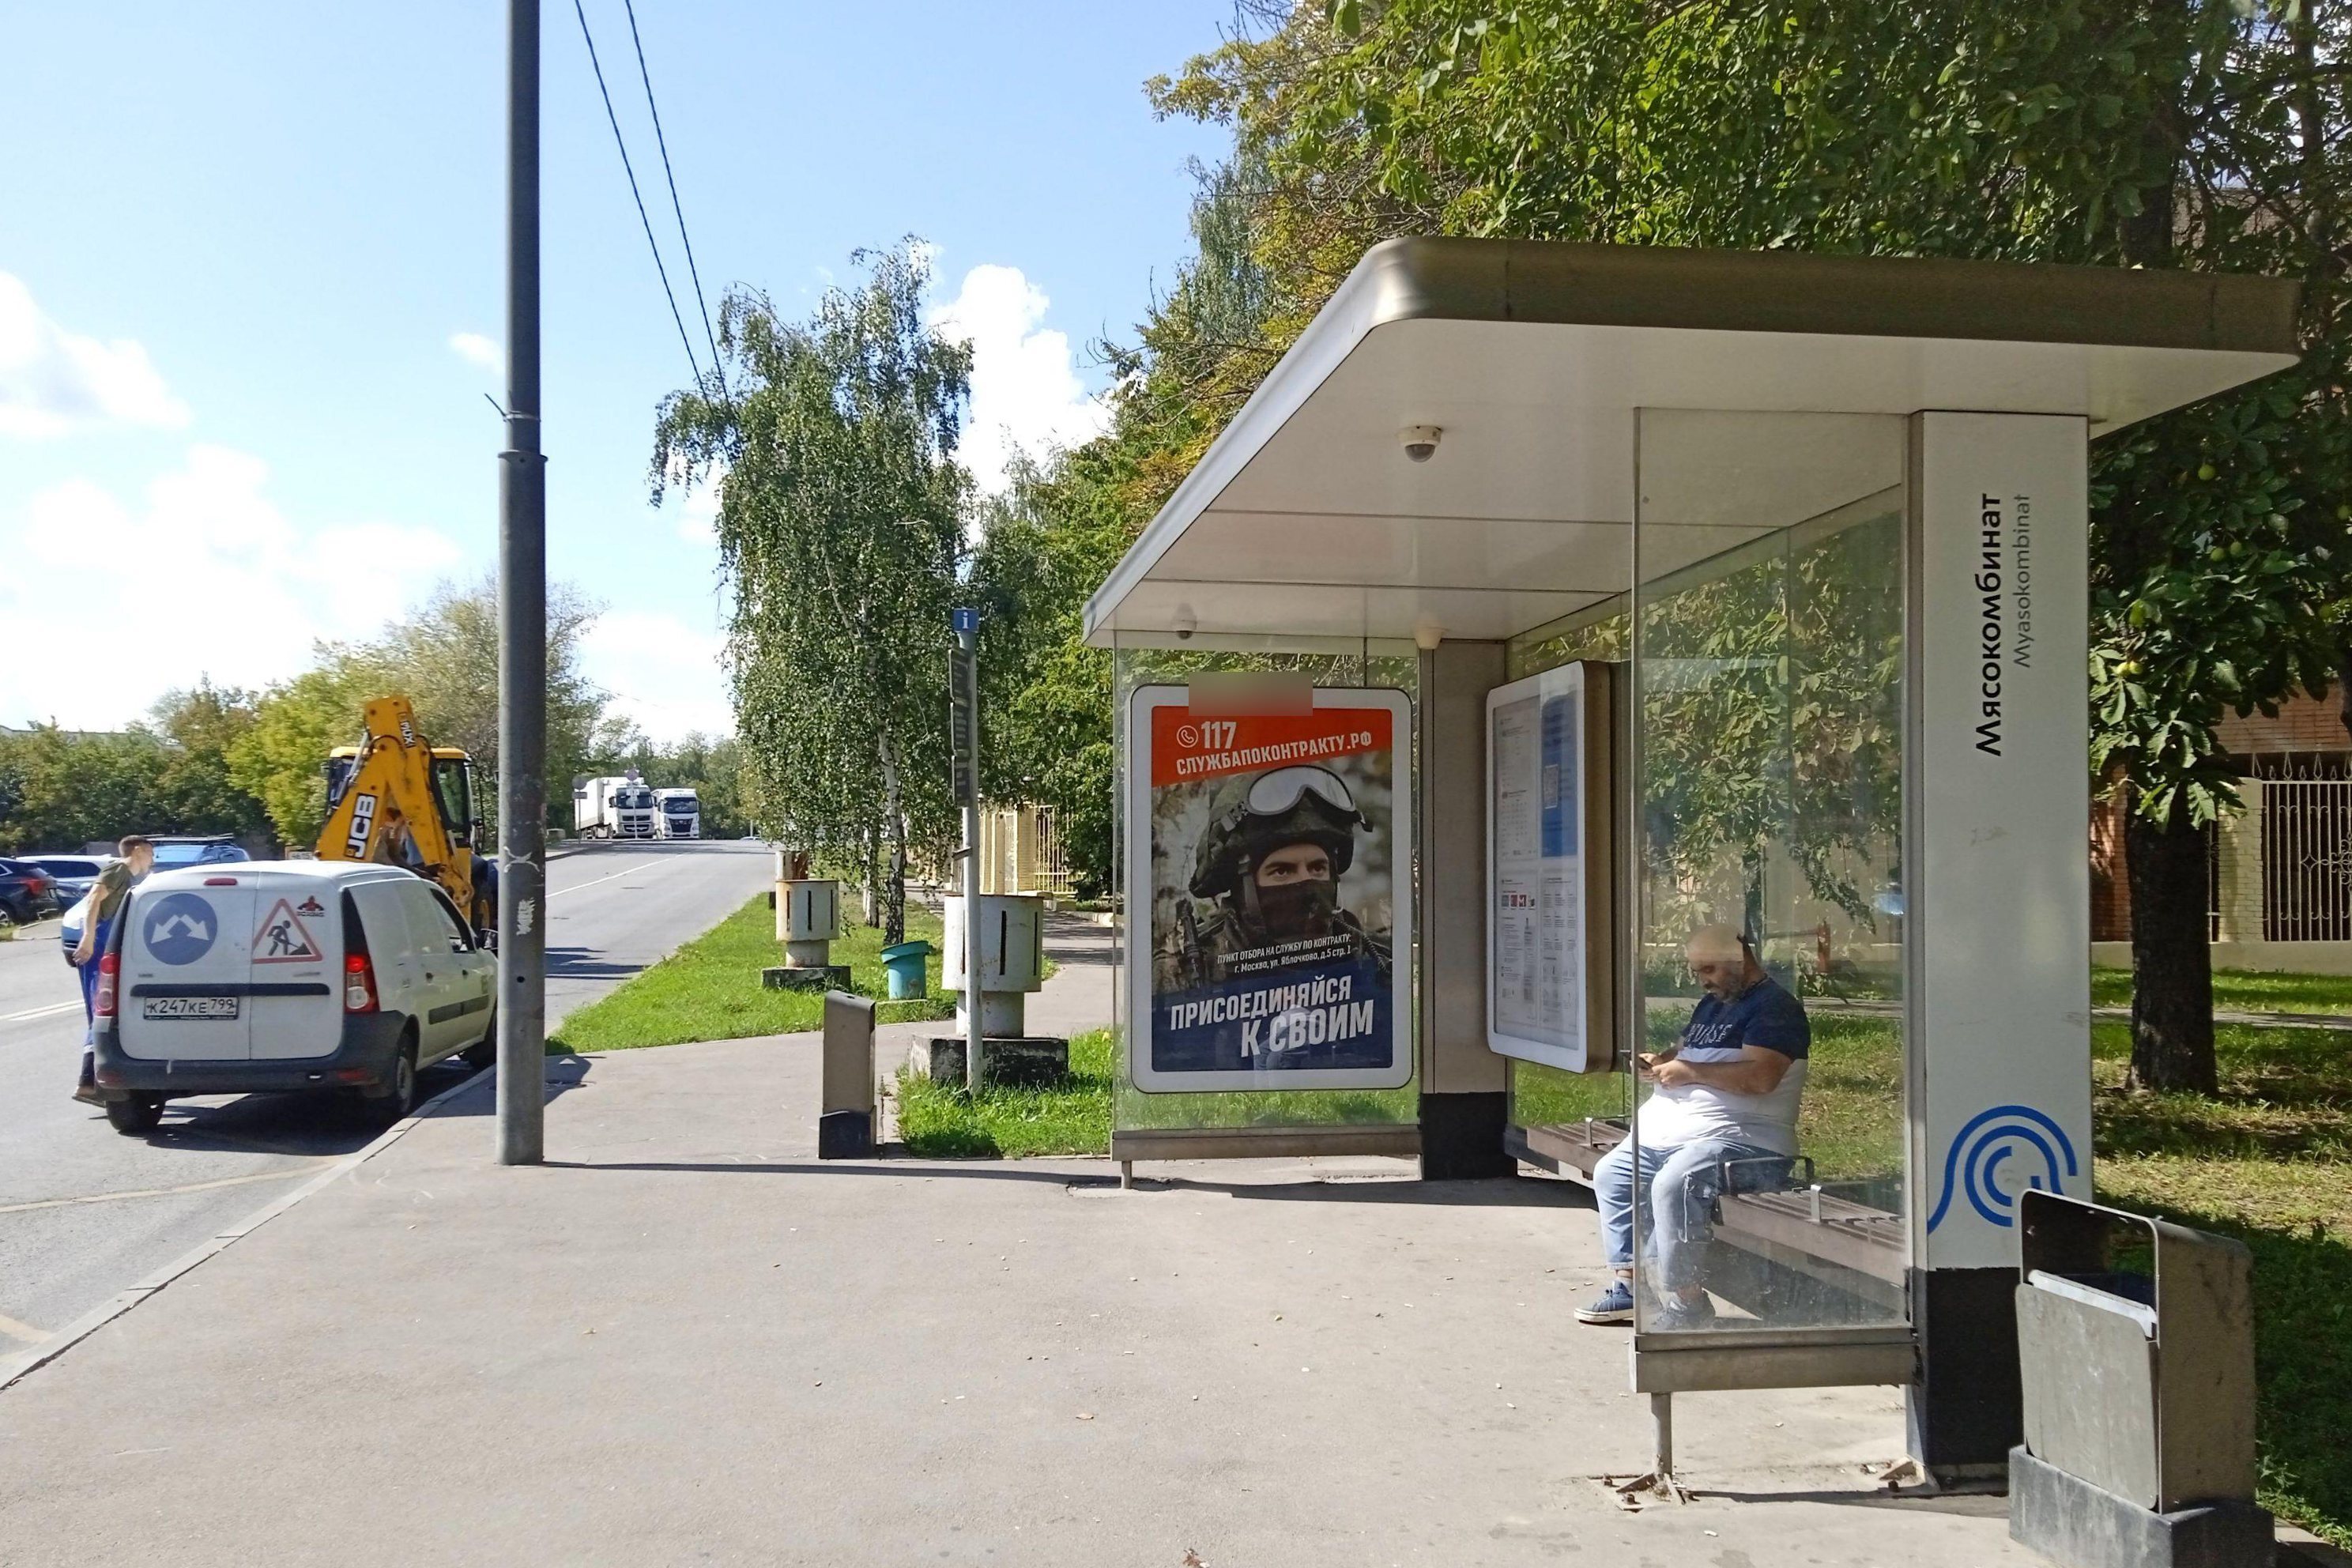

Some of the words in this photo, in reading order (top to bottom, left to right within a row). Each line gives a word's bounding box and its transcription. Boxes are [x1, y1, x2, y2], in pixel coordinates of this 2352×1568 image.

[2011, 494, 2034, 668] Myasokombinat
[1976, 493, 2002, 756] Мясокомбинат
[1176, 731, 1372, 775] СЛУЖБАПОКОНТРАКТУ.РФ
[1200, 721, 1237, 749] 117
[346, 795, 376, 858] JCB
[1217, 952, 1239, 964] ПУНКТ
[1240, 948, 1265, 961] ОТБОРА
[1266, 947, 1275, 956] НА
[1276, 942, 1302, 954] СЛУЖБУ
[1302, 940, 1313, 950] ПО
[1314, 933, 1351, 948] КОНТРАКТУ:
[1234, 965, 1240, 974] г.
[1241, 961, 1269, 973] Москва,
[1270, 959, 1279, 969] ул.
[1332, 947, 1346, 959] стр.
[1346, 945, 1351, 954] 1
[210, 998, 234, 1010] 799
[1170, 974, 1352, 1031] ПРИСОЕДИНЯЙСЯ
[1241, 1020, 1262, 1058] К
[1268, 999, 1374, 1053] СВОИМ
